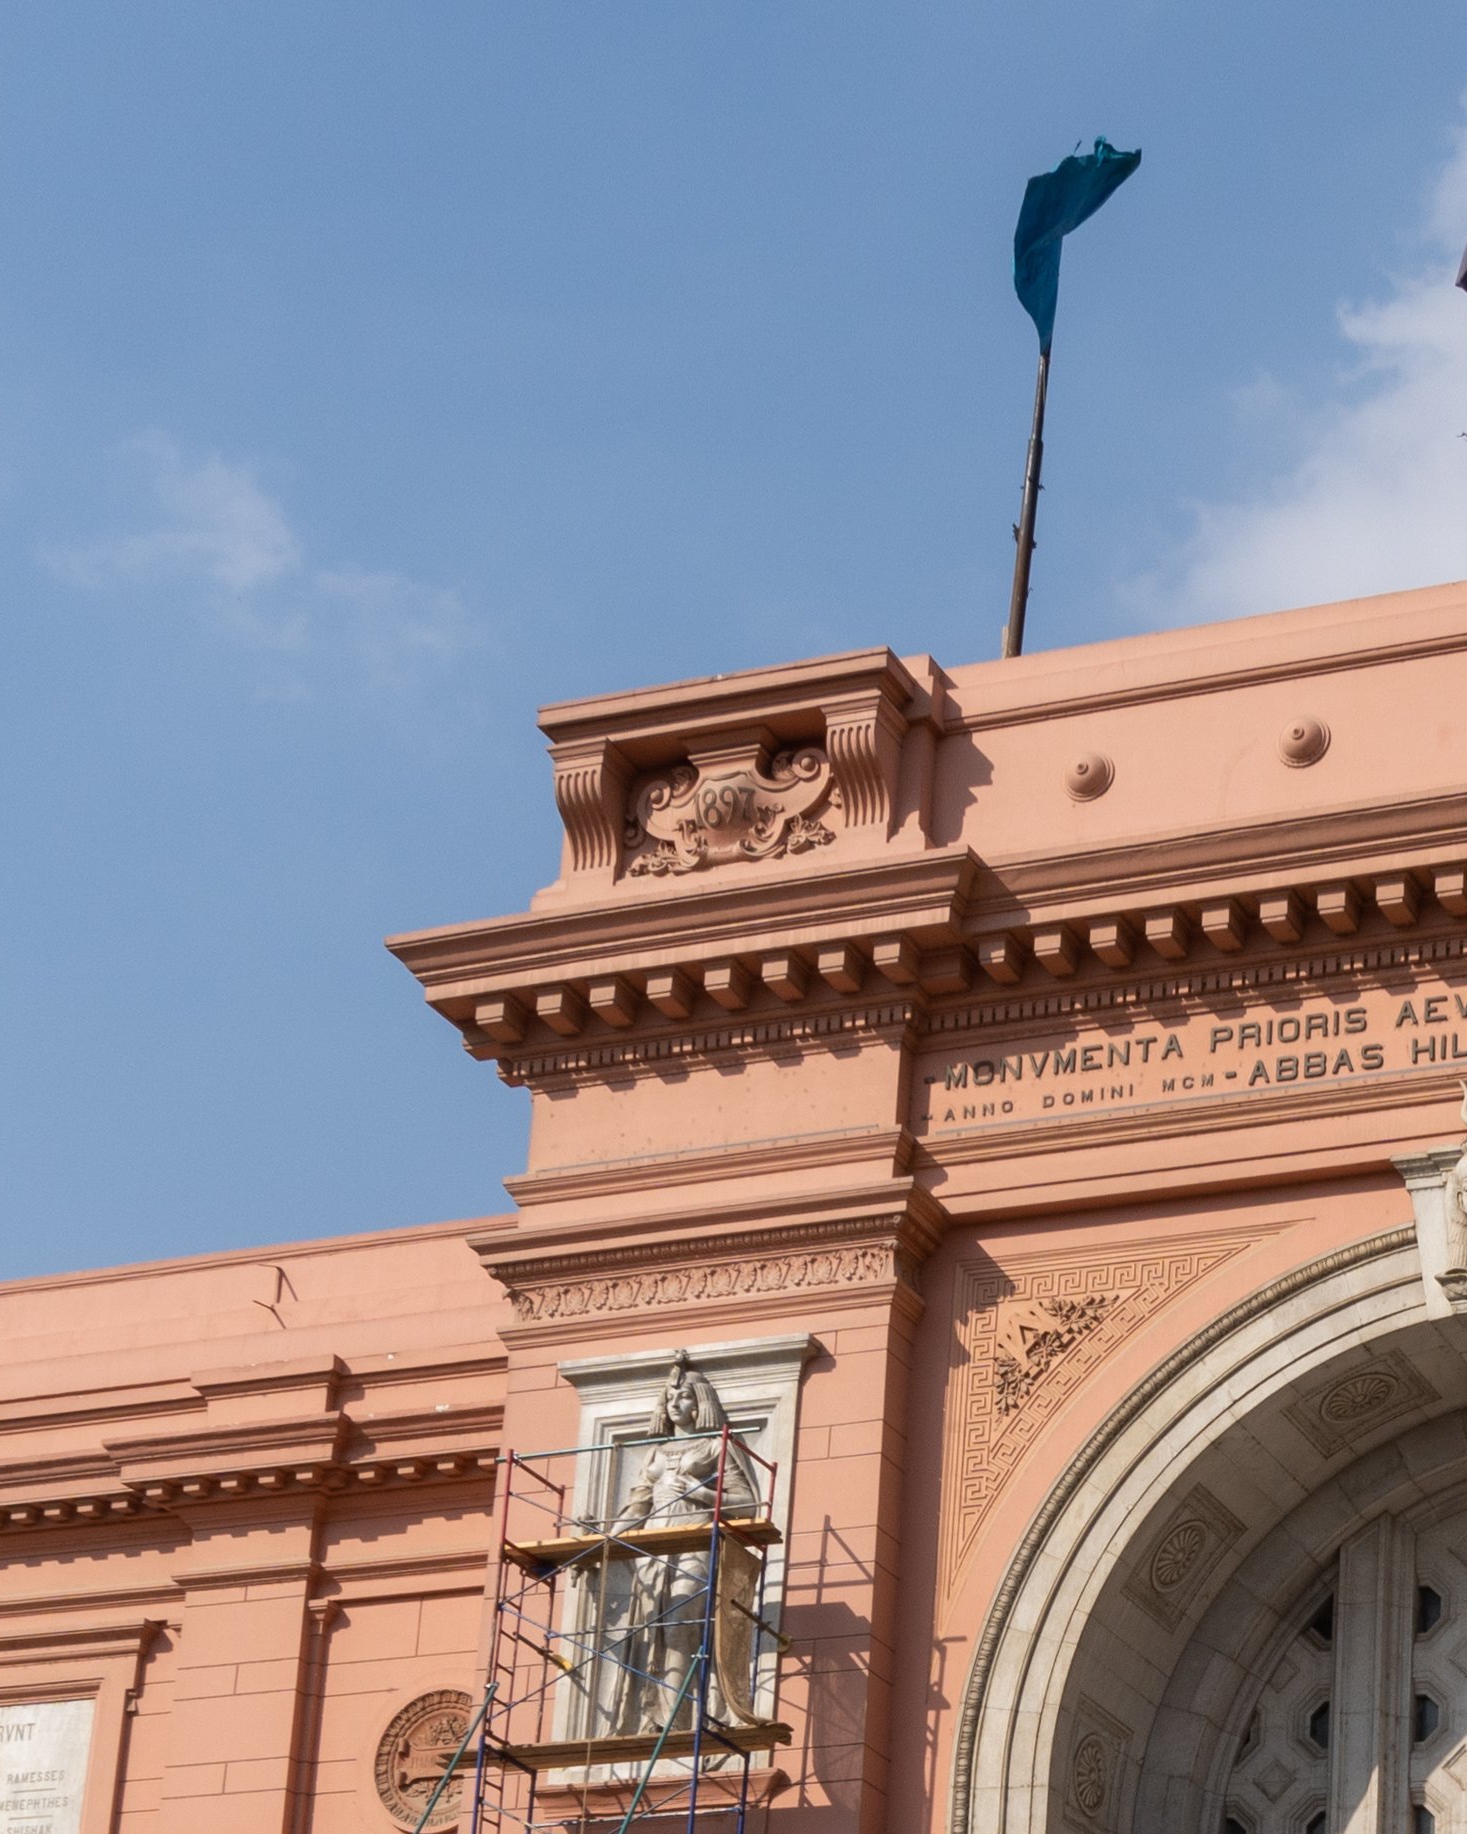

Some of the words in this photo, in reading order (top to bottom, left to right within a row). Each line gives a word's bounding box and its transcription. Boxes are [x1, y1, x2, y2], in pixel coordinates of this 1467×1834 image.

[944, 1035, 1184, 1090] MONVMENTA
[1210, 1007, 1368, 1052] PRIORIS
[944, 1100, 1015, 1122] ANNO
[1043, 1083, 1135, 1109] DOMINI
[1162, 1073, 1215, 1093] MCM
[1249, 1043, 1385, 1086] ABBAS
[6, 1770, 66, 1785] RAMESSES
